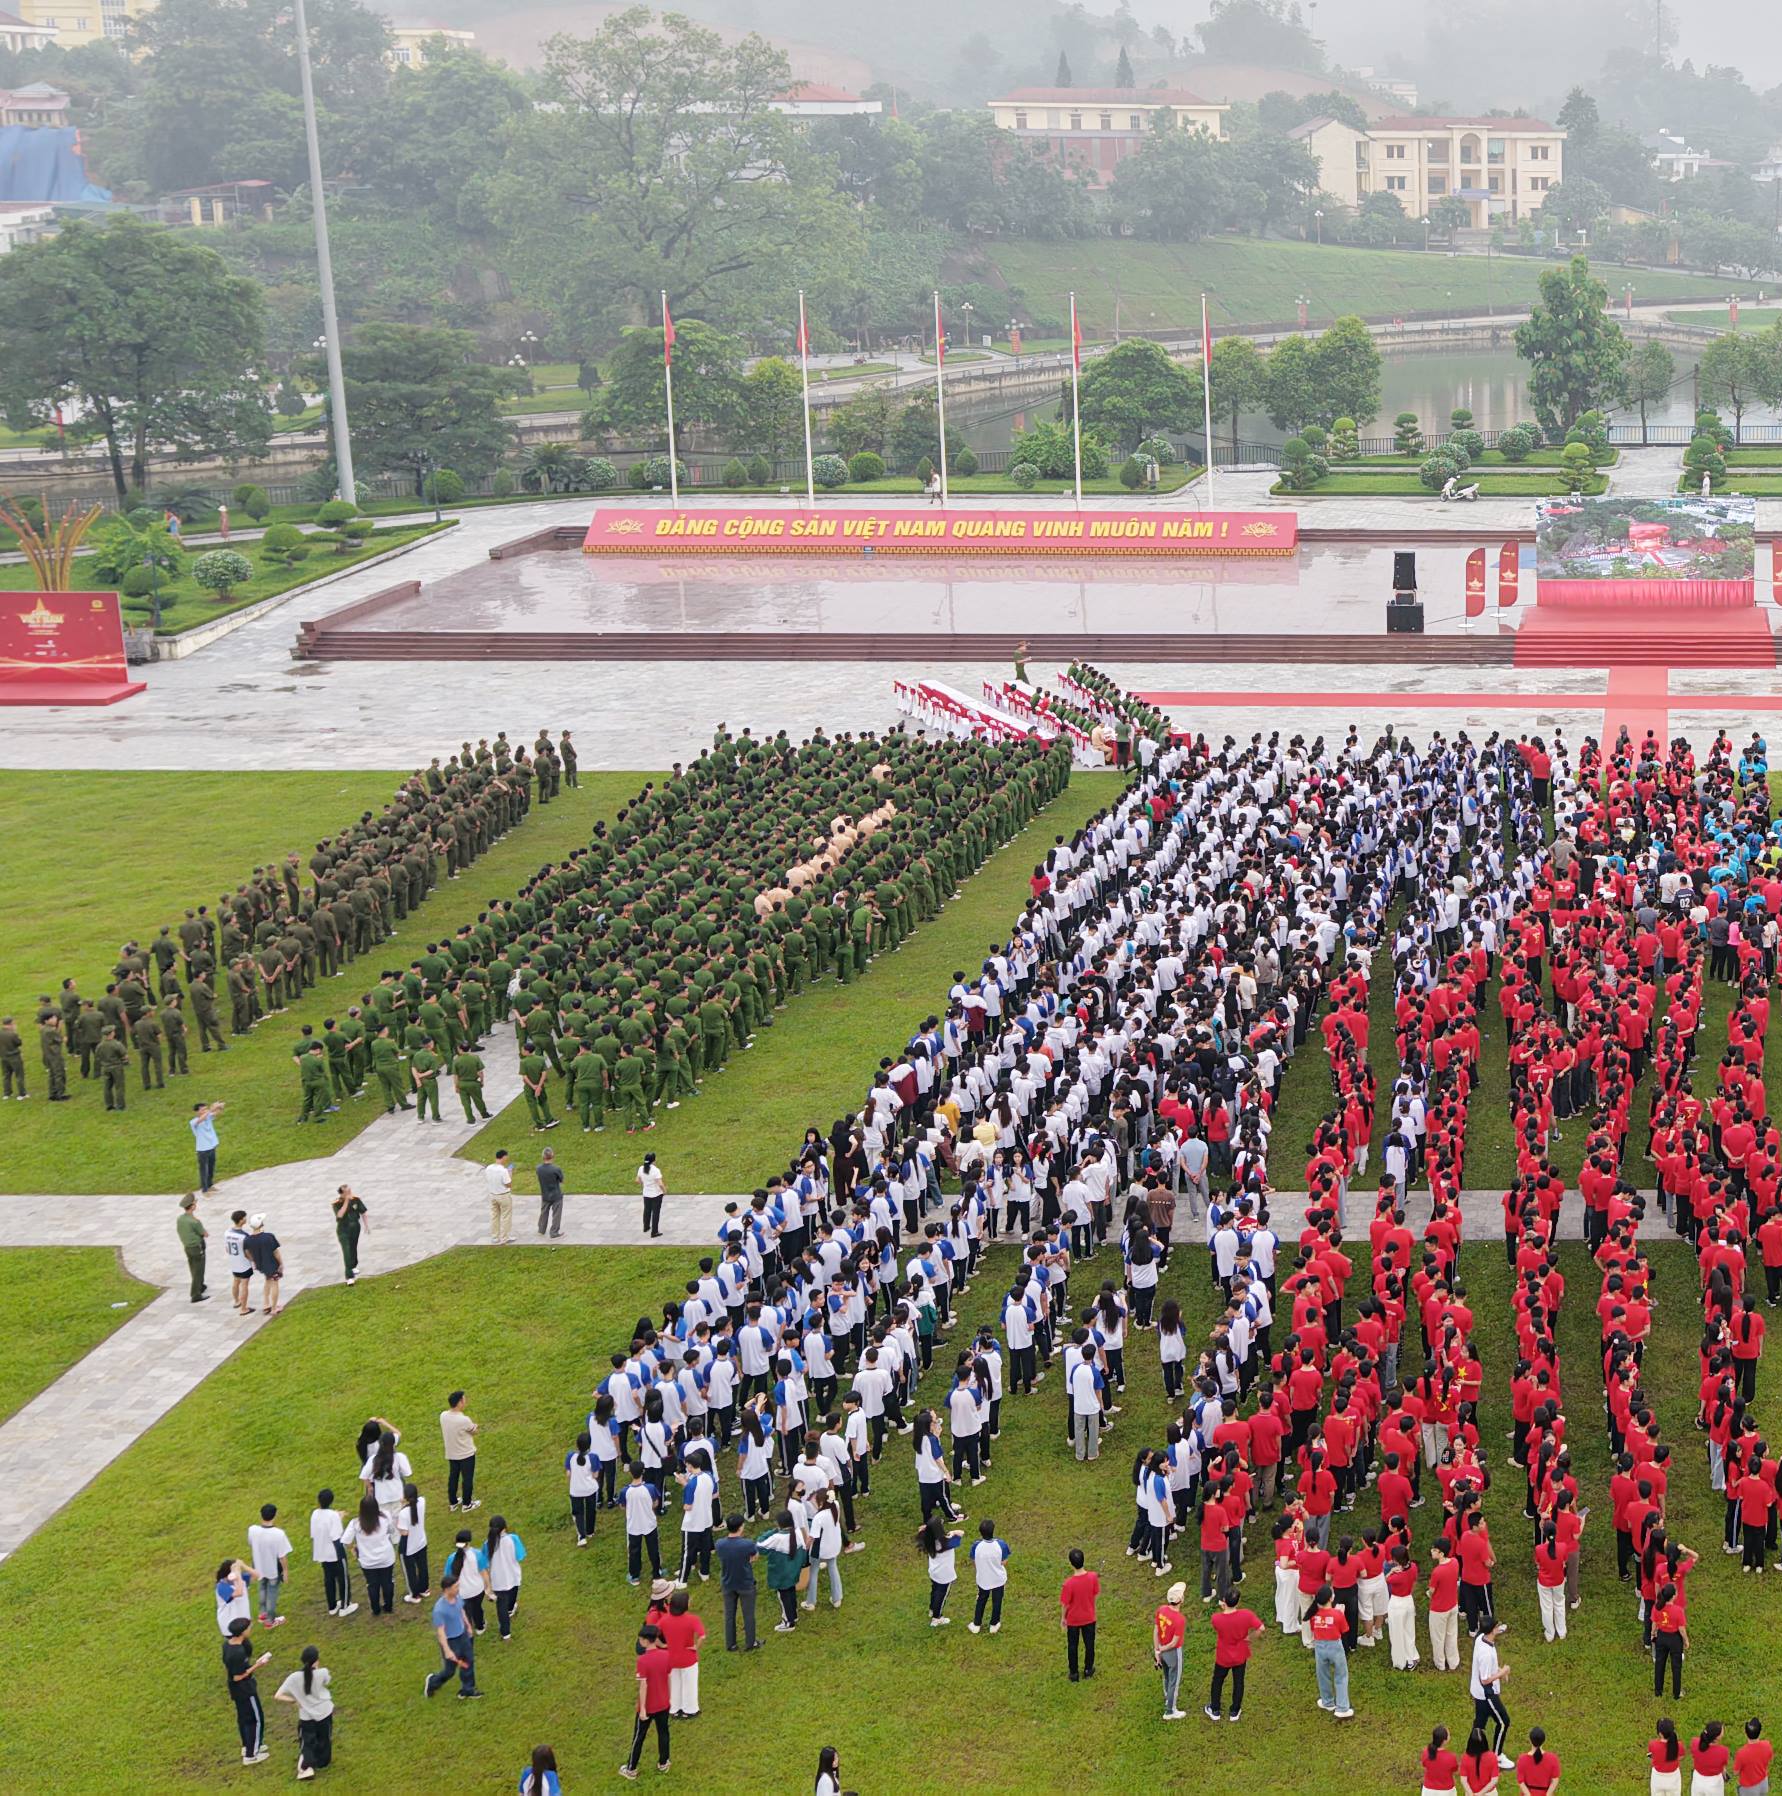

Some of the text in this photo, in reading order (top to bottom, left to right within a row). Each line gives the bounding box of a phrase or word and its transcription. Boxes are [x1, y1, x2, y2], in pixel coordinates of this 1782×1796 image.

[655, 514, 1229, 540] ĐẢNG CỘNG SẢN VIỆT NAM QUANG VINH MUÔN NĂM !
[1679, 897, 1691, 908] 02
